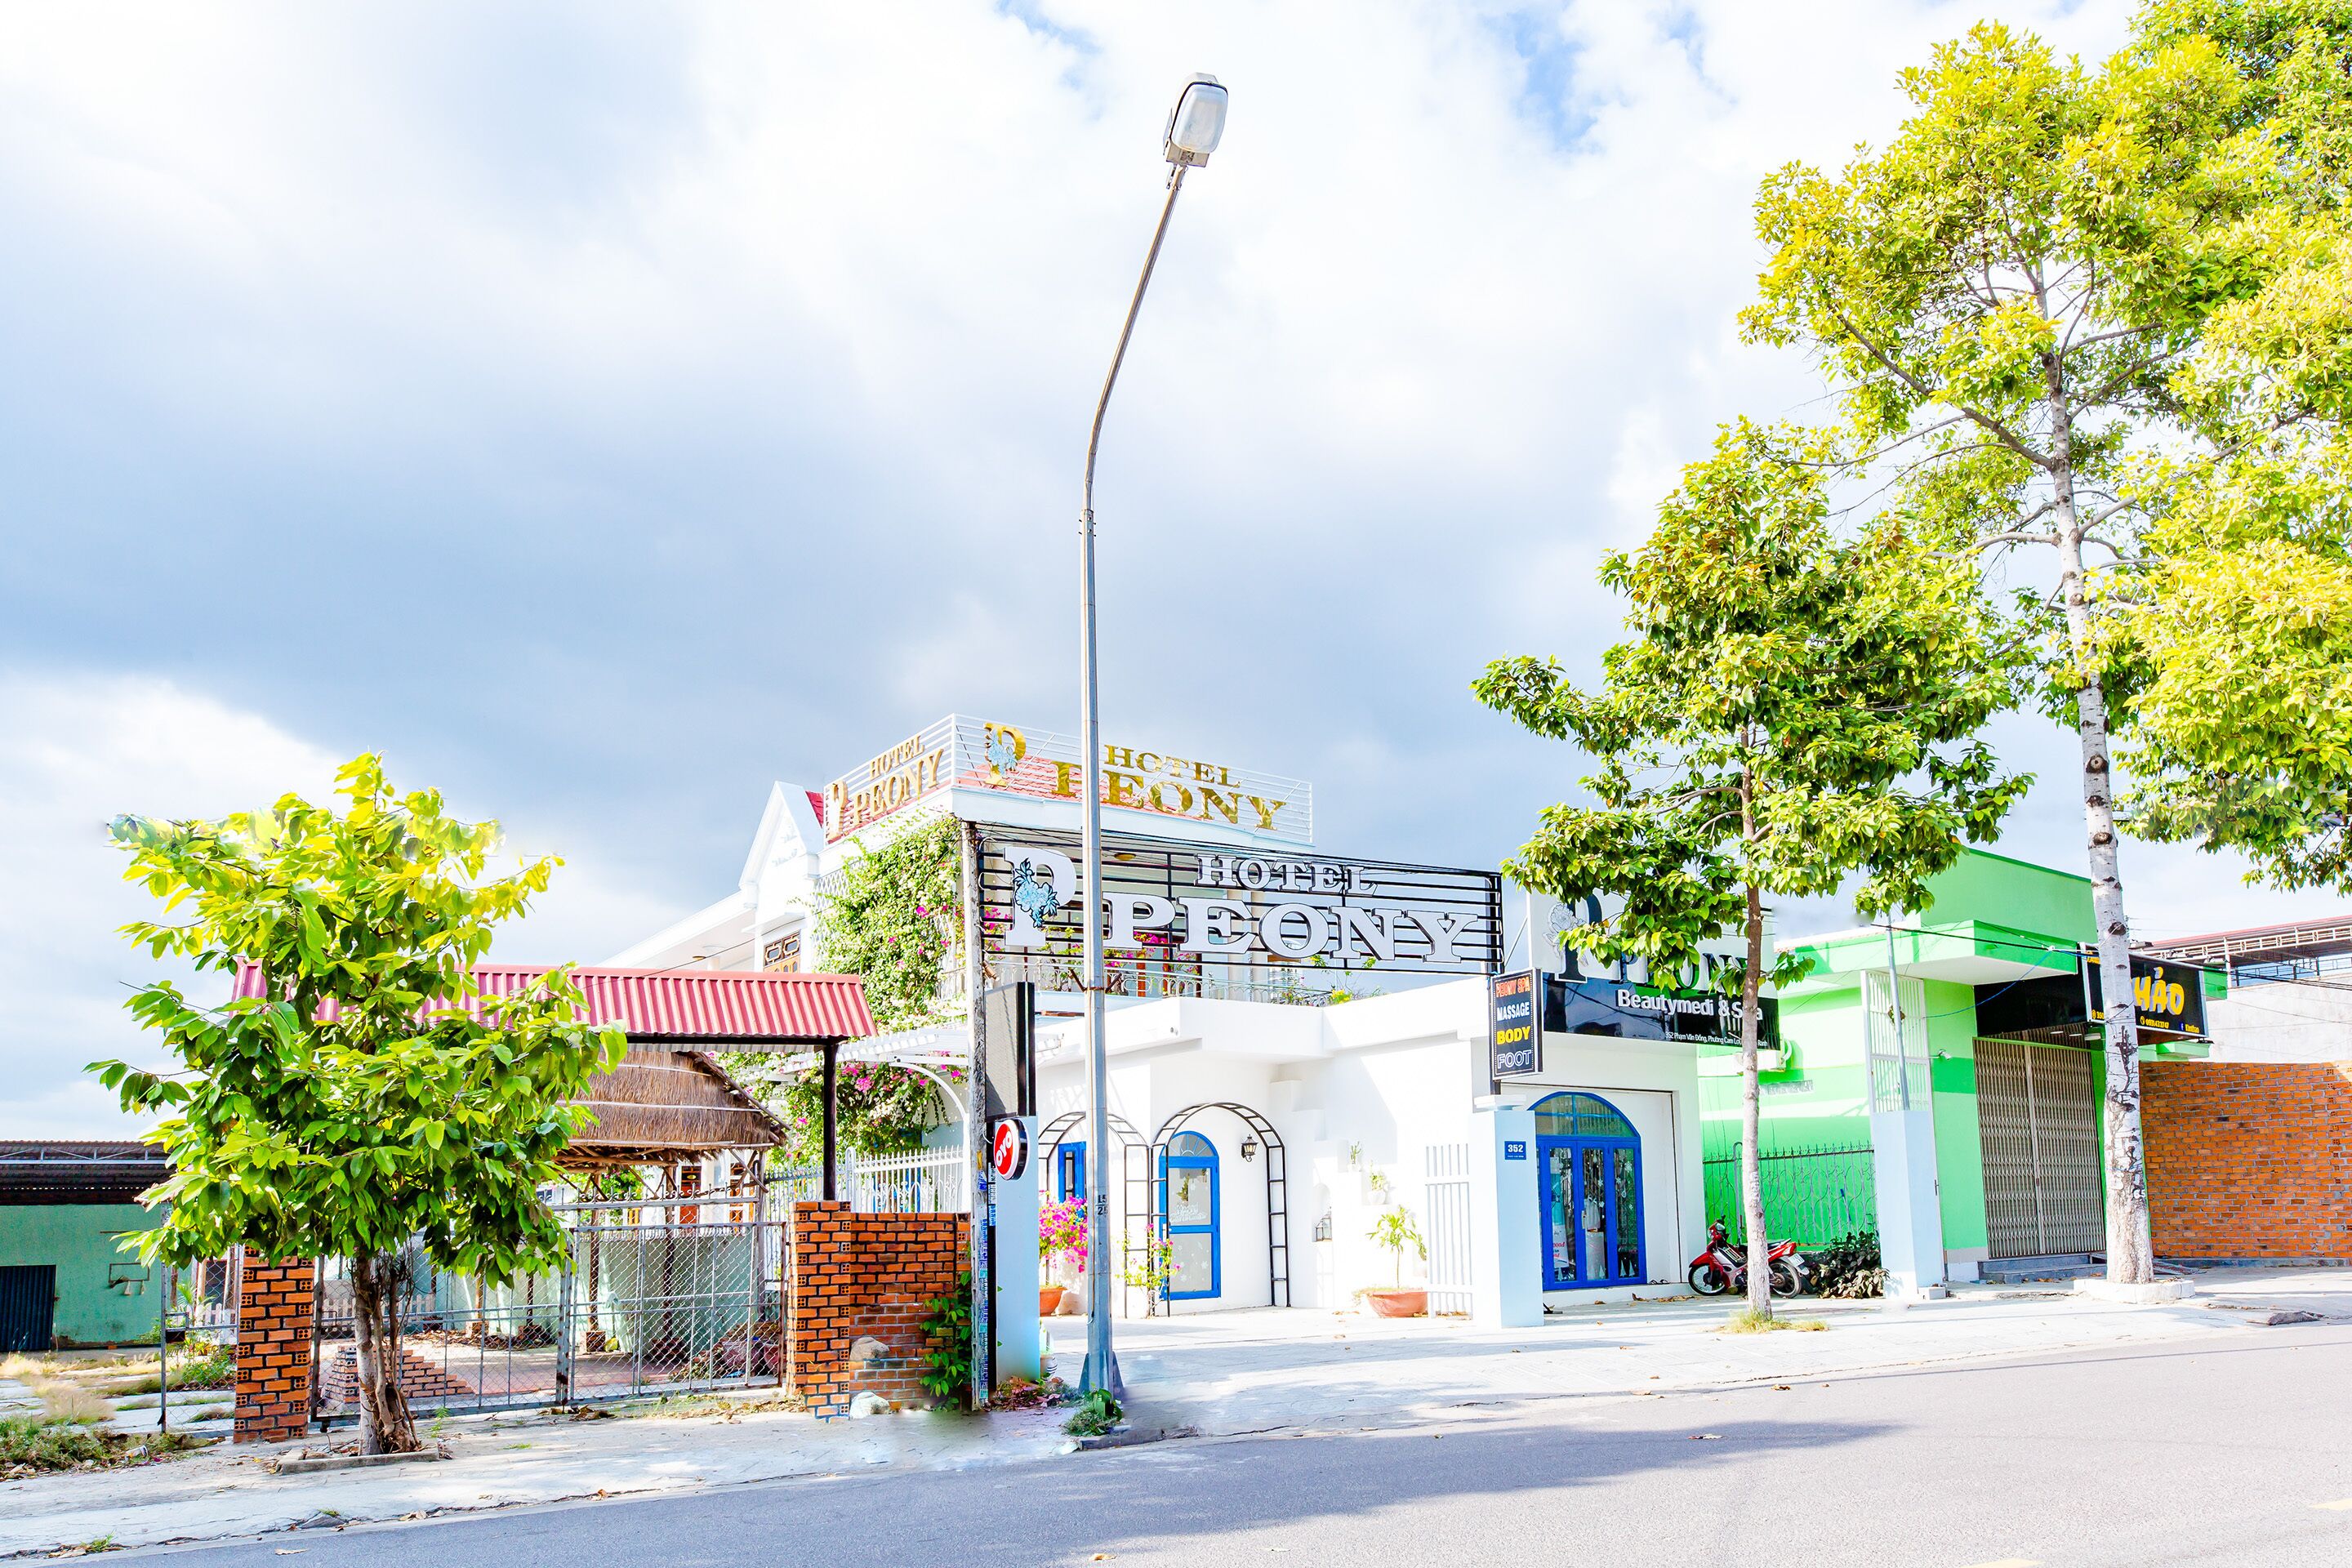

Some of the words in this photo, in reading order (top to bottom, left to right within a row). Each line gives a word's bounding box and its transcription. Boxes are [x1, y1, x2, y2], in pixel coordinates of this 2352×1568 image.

[869, 735, 924, 781] HOTEL
[1104, 744, 1241, 789] HOTEL
[853, 748, 944, 826] PEONY
[1194, 853, 1377, 897] HOTEL
[1102, 891, 1480, 964] PEONY
[1517, 977, 1530, 993] SPA
[2130, 966, 2185, 1015] HẢO
[1497, 1001, 1530, 1021] MASSAGE
[1617, 989, 1714, 1016] Beautymedi
[1718, 998, 1730, 1018] &
[1731, 1001, 1763, 1021] Sa
[1497, 1026, 1531, 1045] BODY
[1665, 1031, 1673, 1040] 352
[1498, 1049, 1531, 1069] FOOT
[996, 1131, 1013, 1167] OYO
[1508, 1144, 1524, 1152] 352
